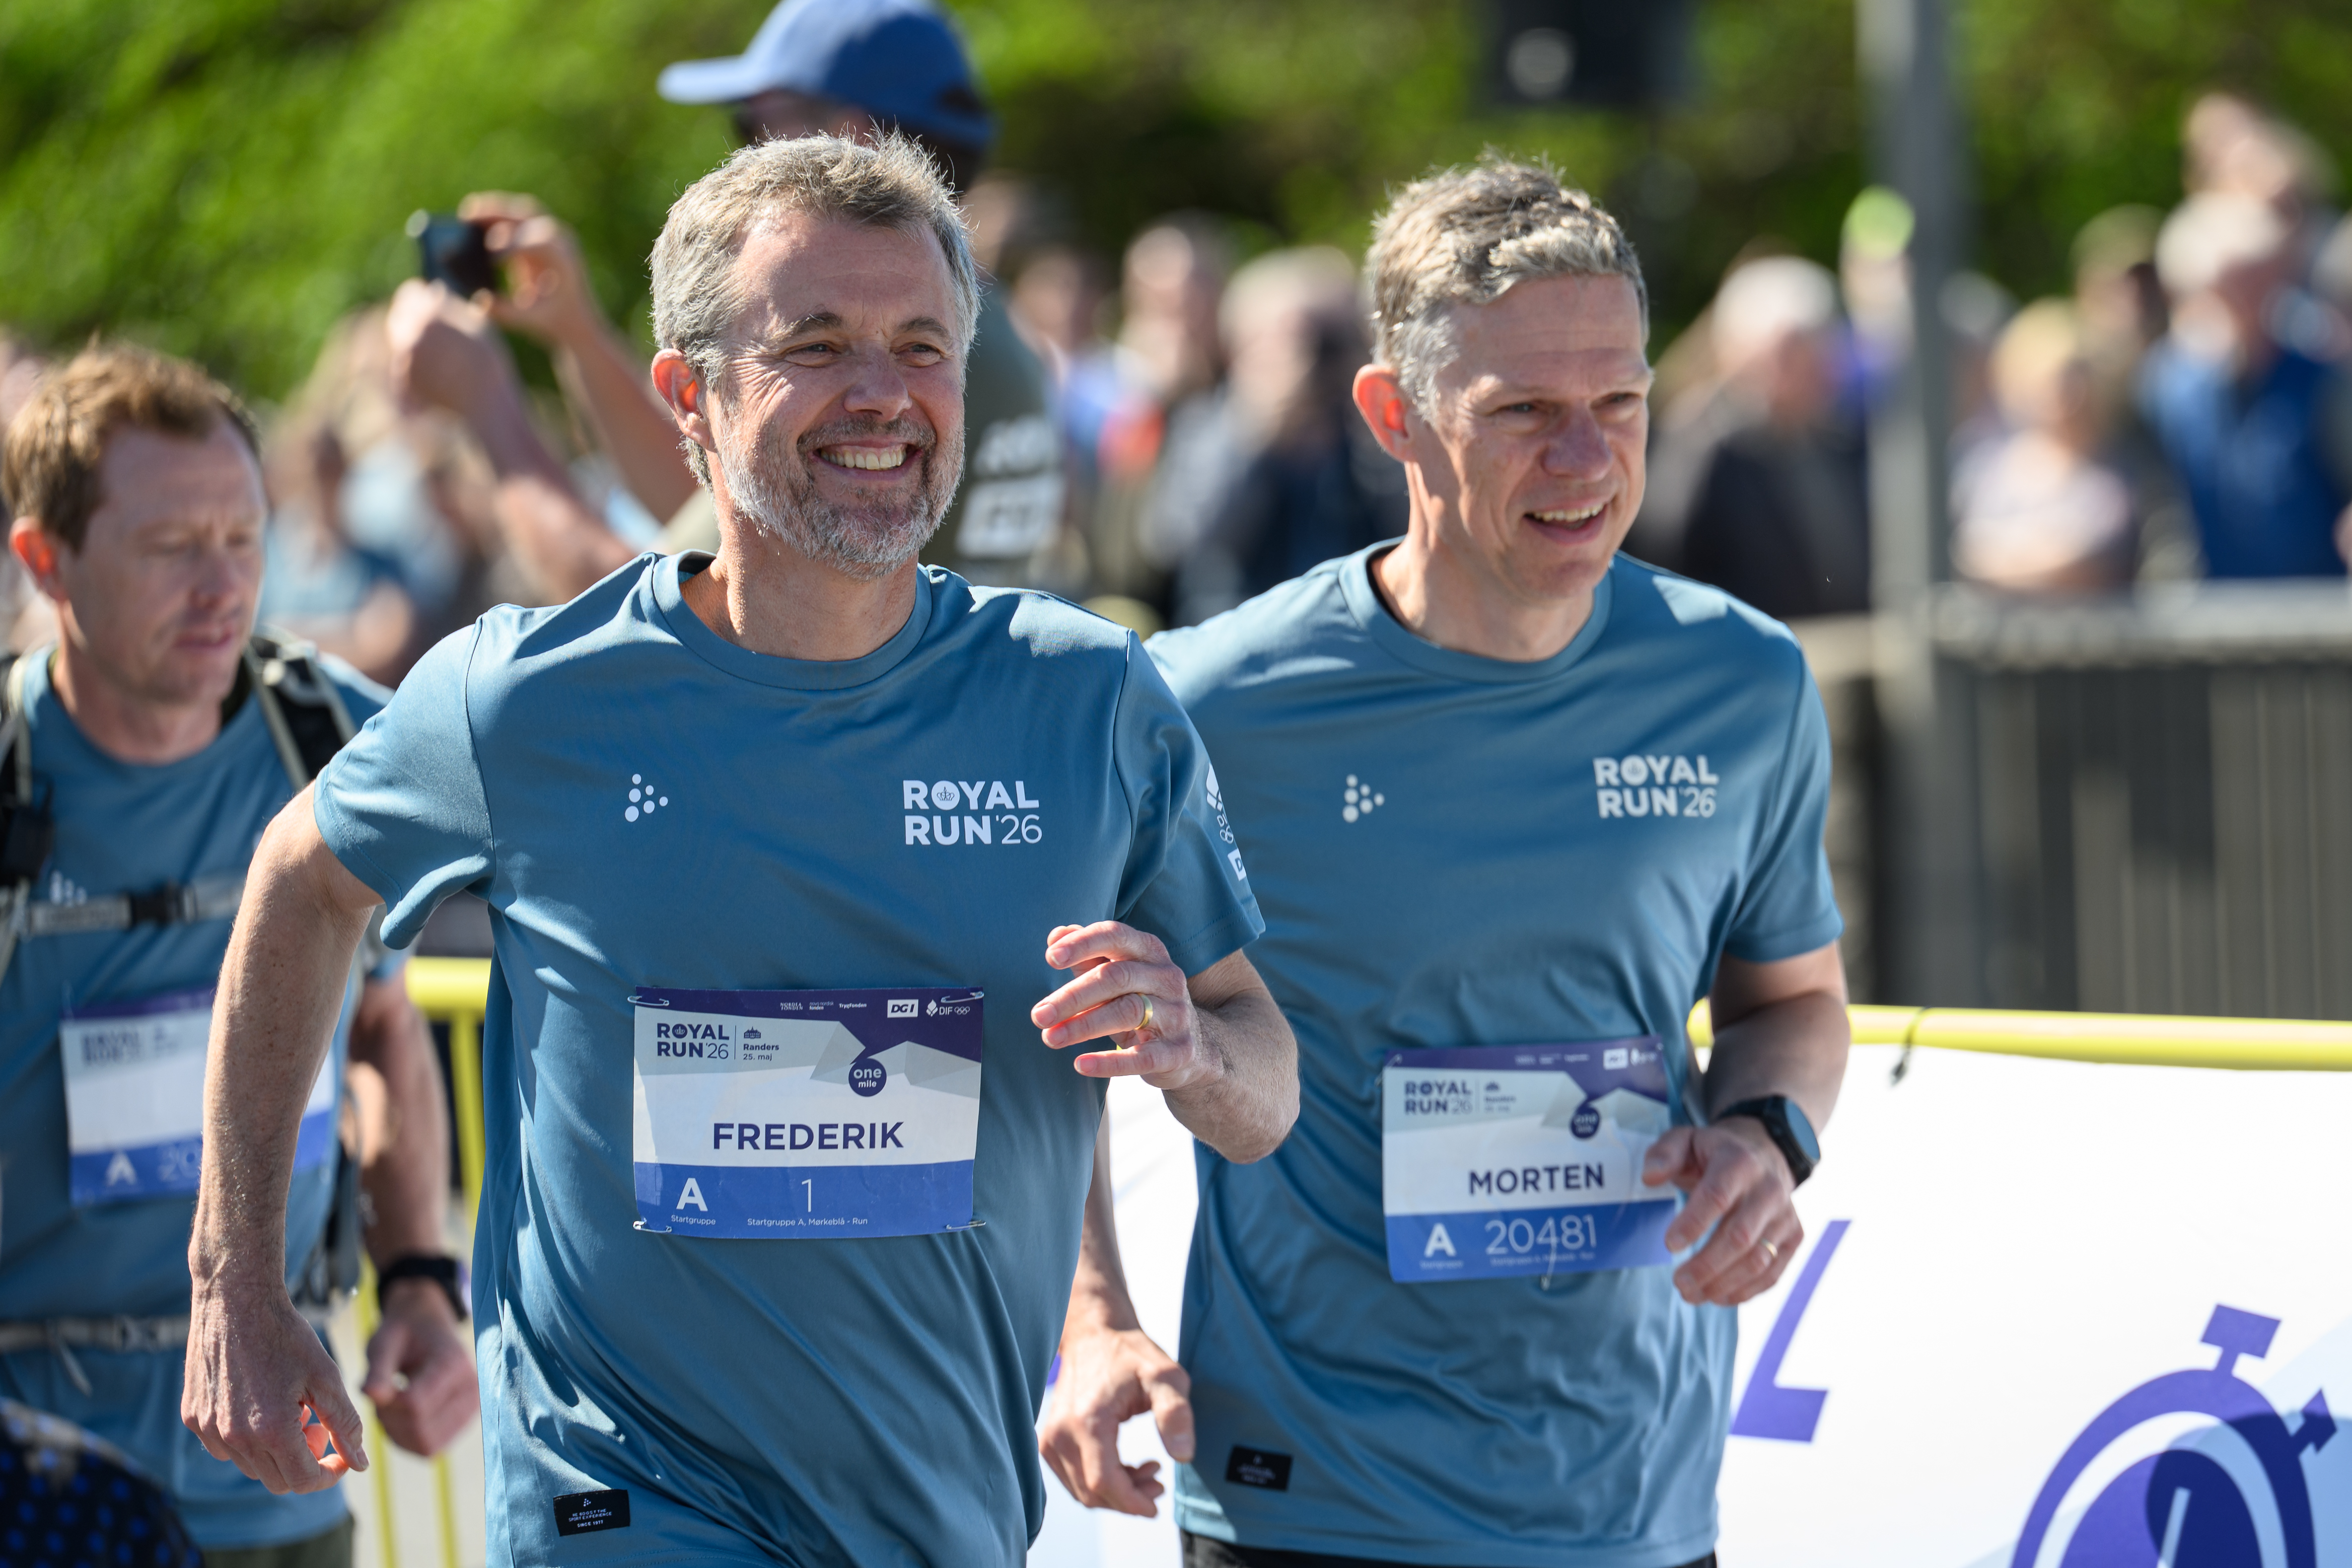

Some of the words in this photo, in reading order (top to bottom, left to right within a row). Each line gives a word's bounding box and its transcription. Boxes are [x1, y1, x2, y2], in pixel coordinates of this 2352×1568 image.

[1593, 754, 1719, 787] ROYAL
[903, 780, 1039, 810] ROYAL
[891, 1004, 915, 1013] DGI
[939, 1007, 953, 1015] DIF
[657, 1023, 729, 1040] ROYAL
[758, 1053, 772, 1061] maj
[853, 1068, 882, 1079] one
[858, 1080, 877, 1088] mile
[1405, 1080, 1472, 1097] ROYAL
[714, 1121, 904, 1150] FREDERIK
[1469, 1162, 1604, 1196] MORTEN
[676, 1177, 708, 1211] A
[802, 1178, 812, 1213] 1
[671, 1215, 716, 1226] Startgruppe
[747, 1218, 796, 1227] Startgruppe
[798, 1218, 806, 1226] A,
[808, 1217, 845, 1226] Mørkeblå
[852, 1217, 868, 1225] Run
[1424, 1222, 1457, 1258] A
[1485, 1214, 1597, 1255] 20481
[582, 1512, 612, 1520] EXPERIENCE
